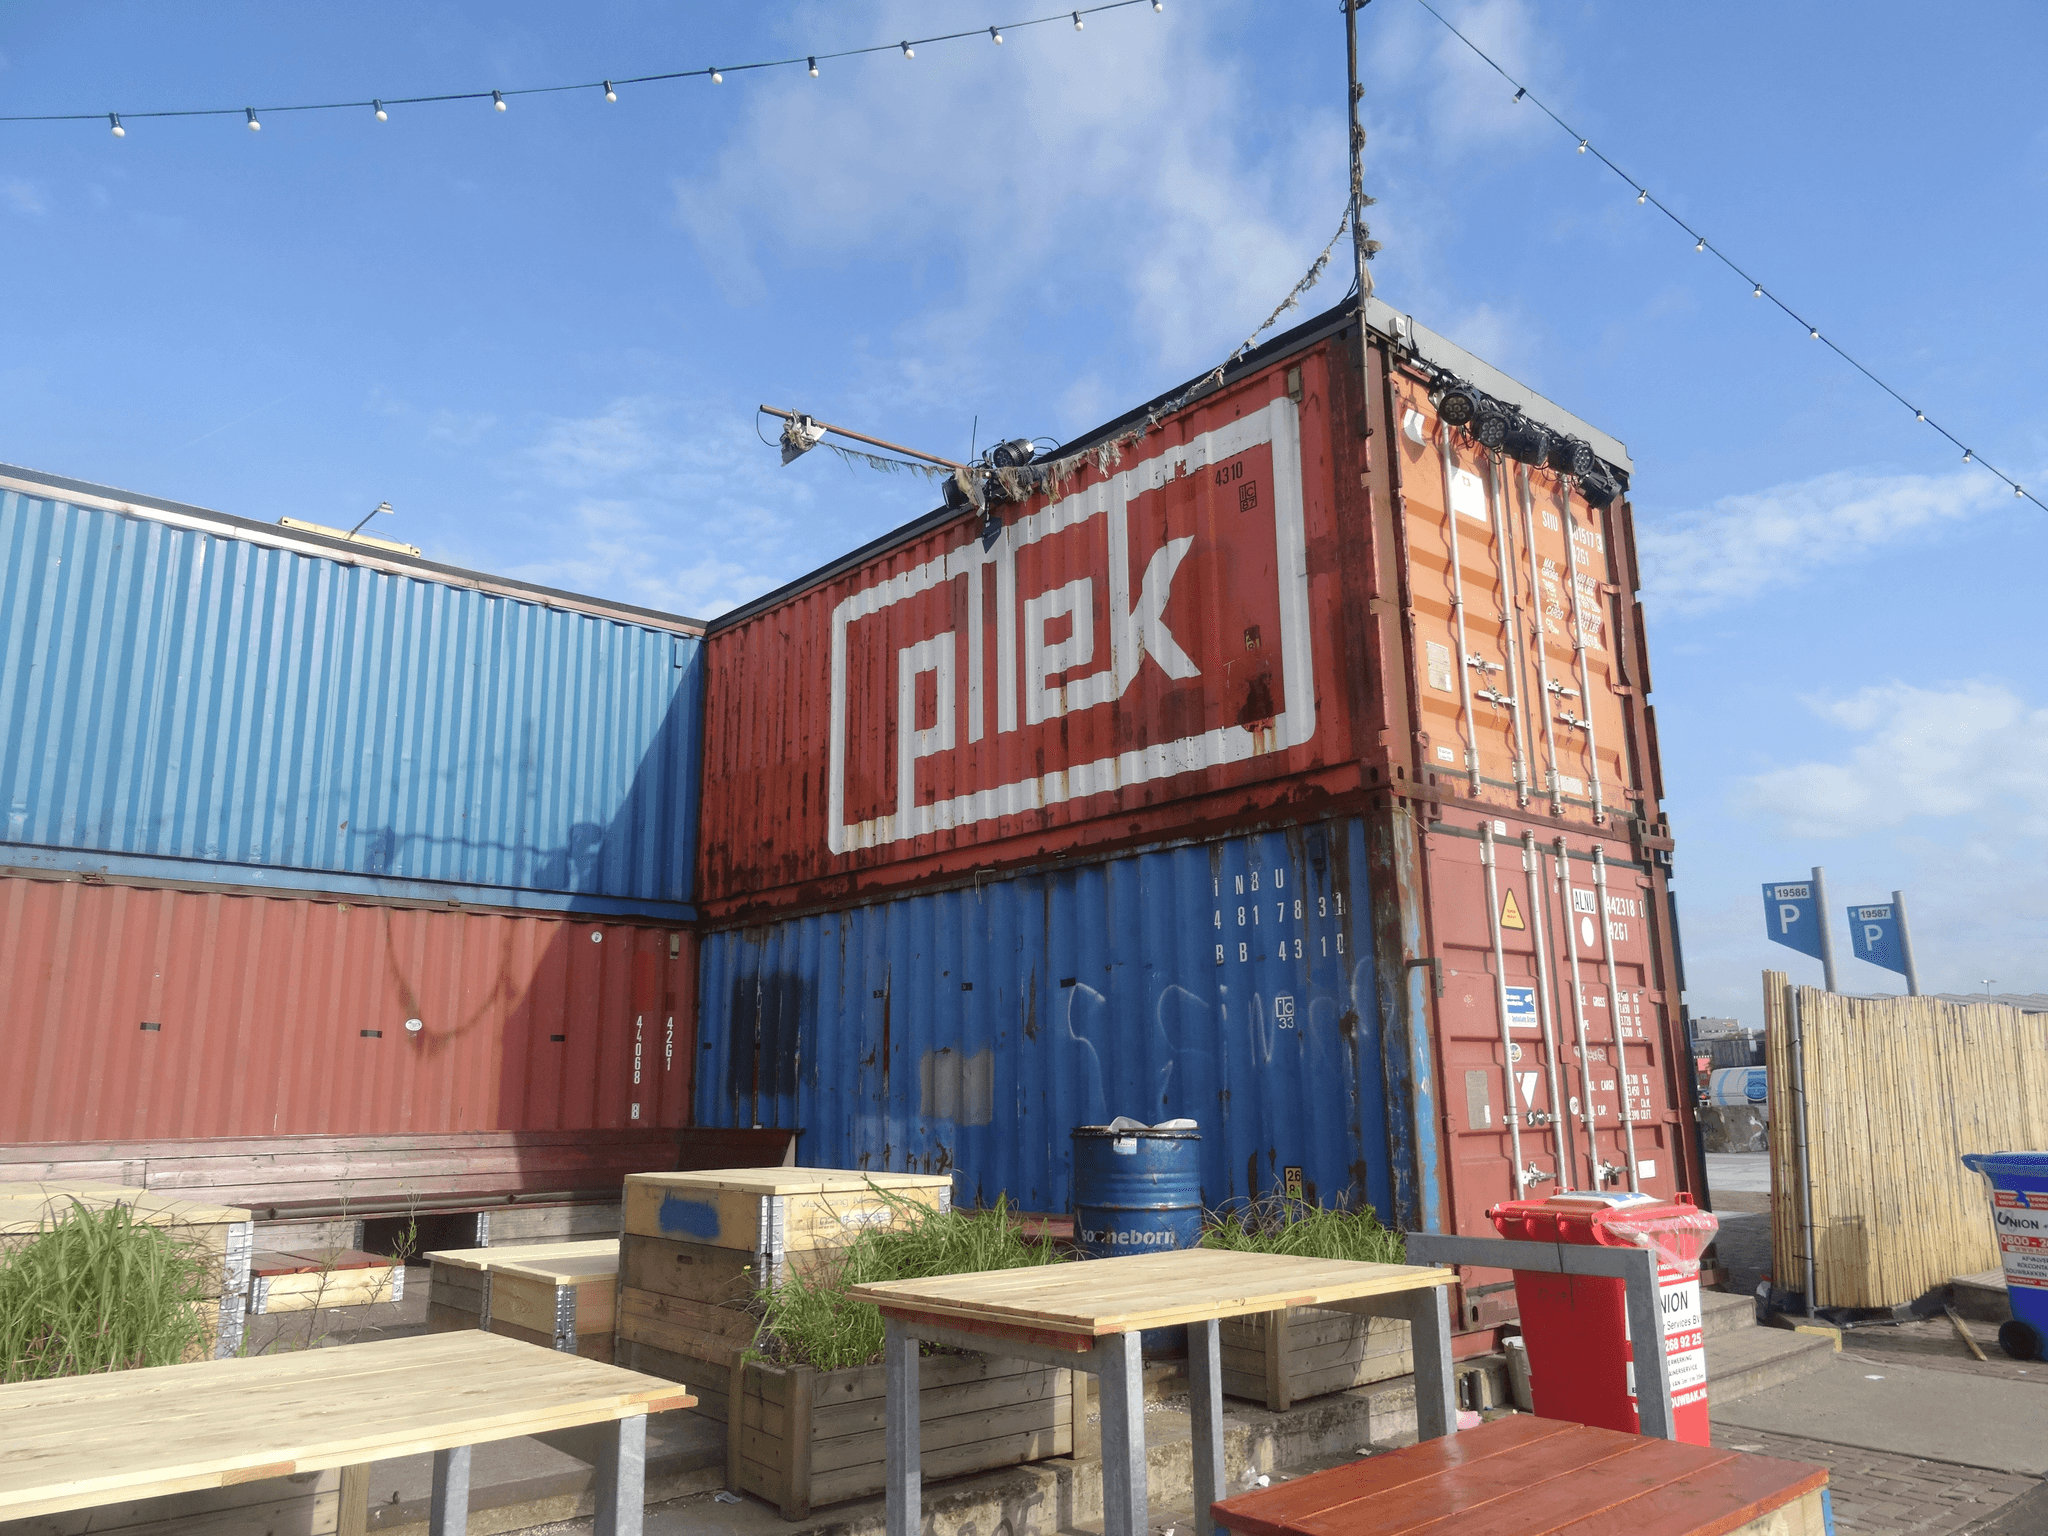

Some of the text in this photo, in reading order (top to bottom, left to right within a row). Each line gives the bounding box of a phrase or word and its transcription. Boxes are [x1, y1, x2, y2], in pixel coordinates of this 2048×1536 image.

[1215, 461, 1243, 487] 4310
[1776, 888, 1808, 898] 19586
[1778, 904, 1801, 935] P
[1860, 908, 1889, 919] 19587
[1863, 924, 1884, 951] P
[1278, 1016, 1294, 1029] 33
[633, 1015, 643, 1084] 44068
[665, 1016, 674, 1071] 42G1
[1997, 1211, 2039, 1230] UNION
[1081, 1229, 1176, 1246] soneborn
[2000, 1234, 2030, 1246] 0800
[2039, 1238, 2048, 1248] 2
[2016, 1262, 2048, 1271] ROLCONTA
[2021, 1256, 2048, 1264] AFVALVER
[1660, 1290, 1688, 1314] NION
[1666, 1318, 1691, 1331] Services
[1680, 1334, 1691, 1348] 92
[1691, 1332, 1702, 1346] 25
[1667, 1354, 1693, 1367] ERWERKING
[1671, 1387, 1708, 1409] OUWBAK.NL
